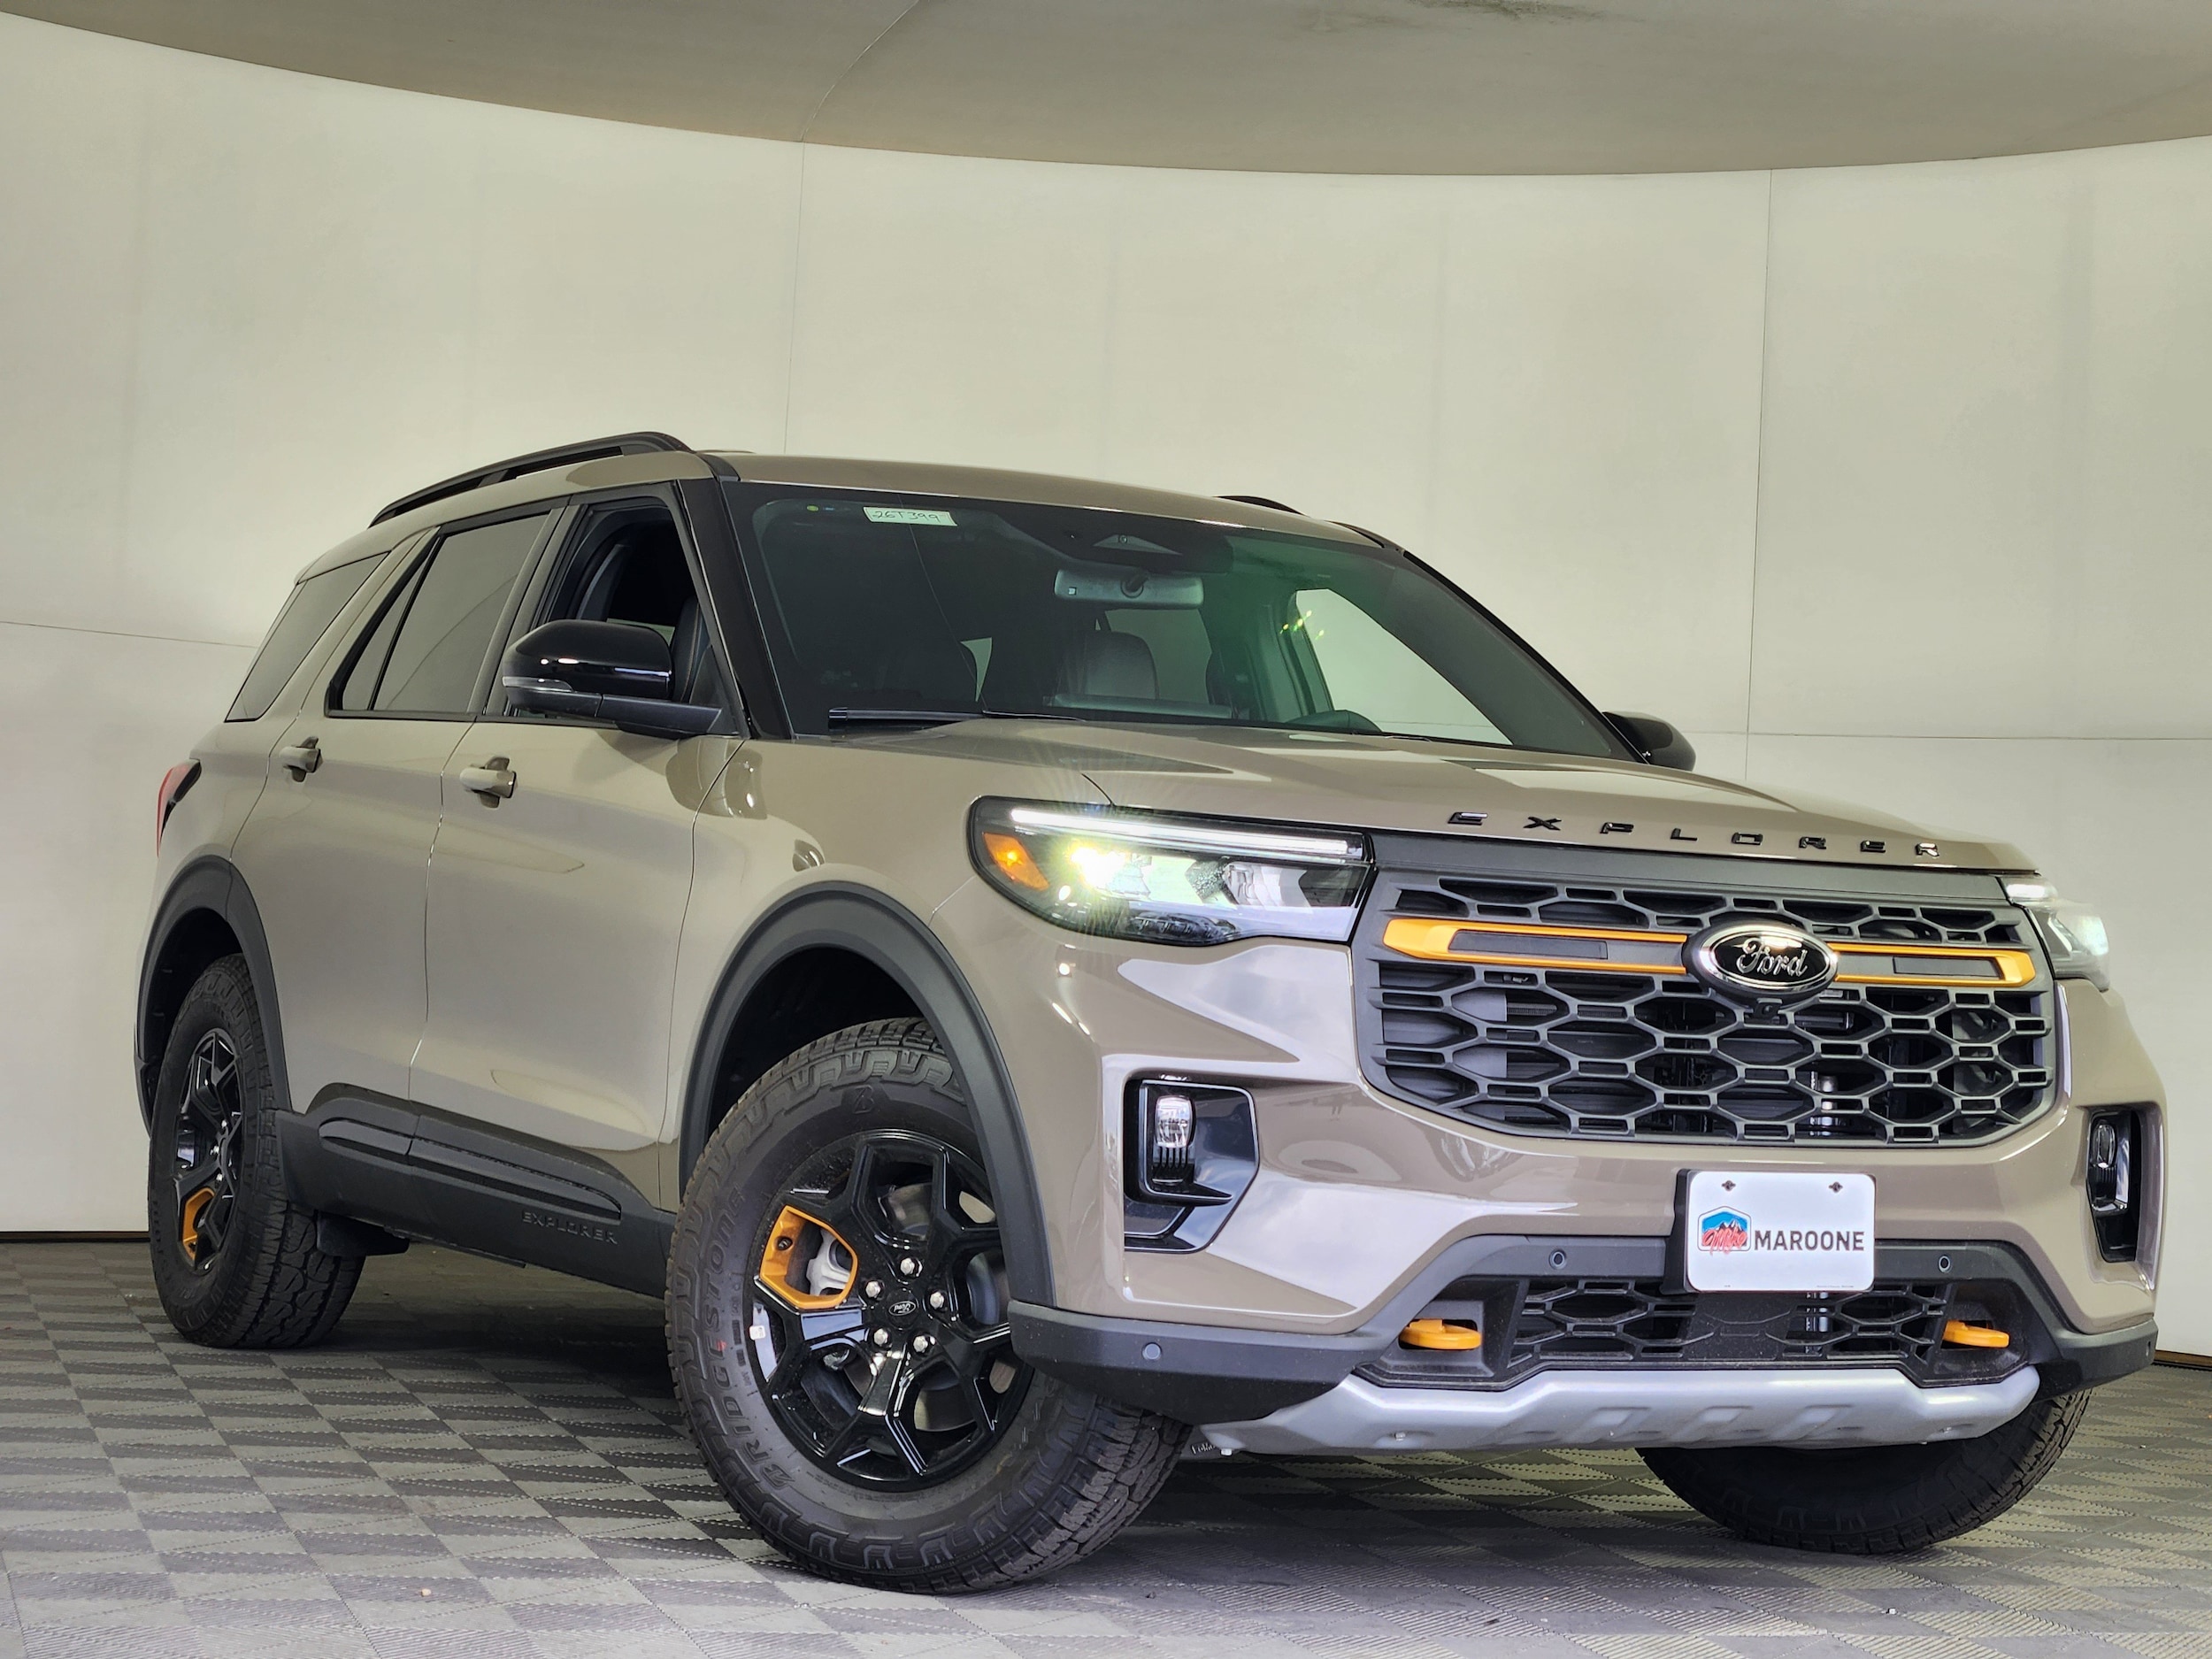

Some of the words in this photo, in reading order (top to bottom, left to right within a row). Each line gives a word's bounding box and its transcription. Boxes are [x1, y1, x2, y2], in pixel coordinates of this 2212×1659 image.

[872, 511, 941, 522] 26T399
[1448, 811, 1939, 856] EXPLORER
[1736, 939, 1809, 978] Ford
[522, 1211, 618, 1244] EXPLORER
[1754, 1230, 1864, 1251] MAROONE
